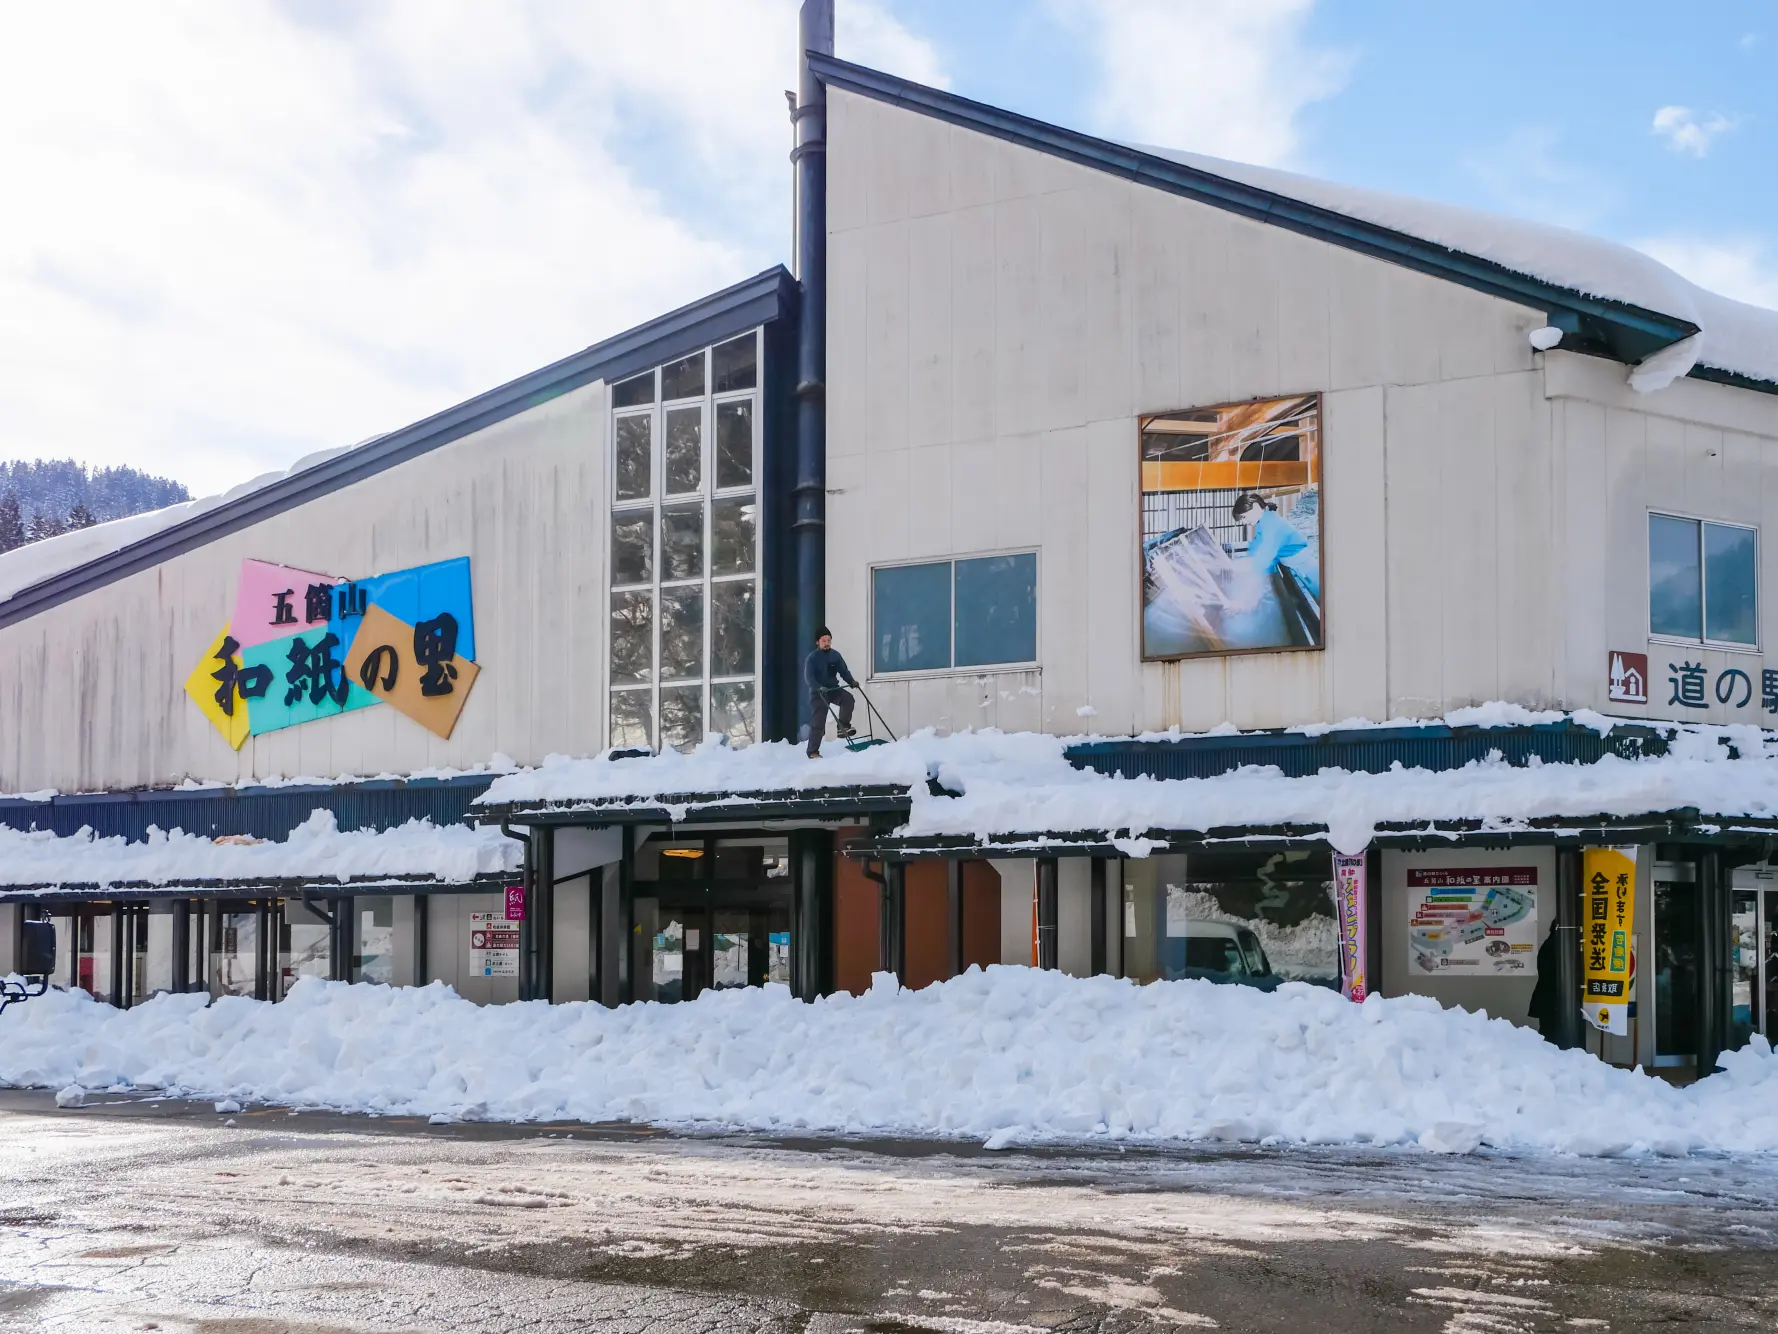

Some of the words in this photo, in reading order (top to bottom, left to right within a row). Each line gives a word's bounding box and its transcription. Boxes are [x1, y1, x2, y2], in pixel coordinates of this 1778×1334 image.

[269, 583, 367, 626] 五箇山
[211, 612, 458, 716] 和紙の里
